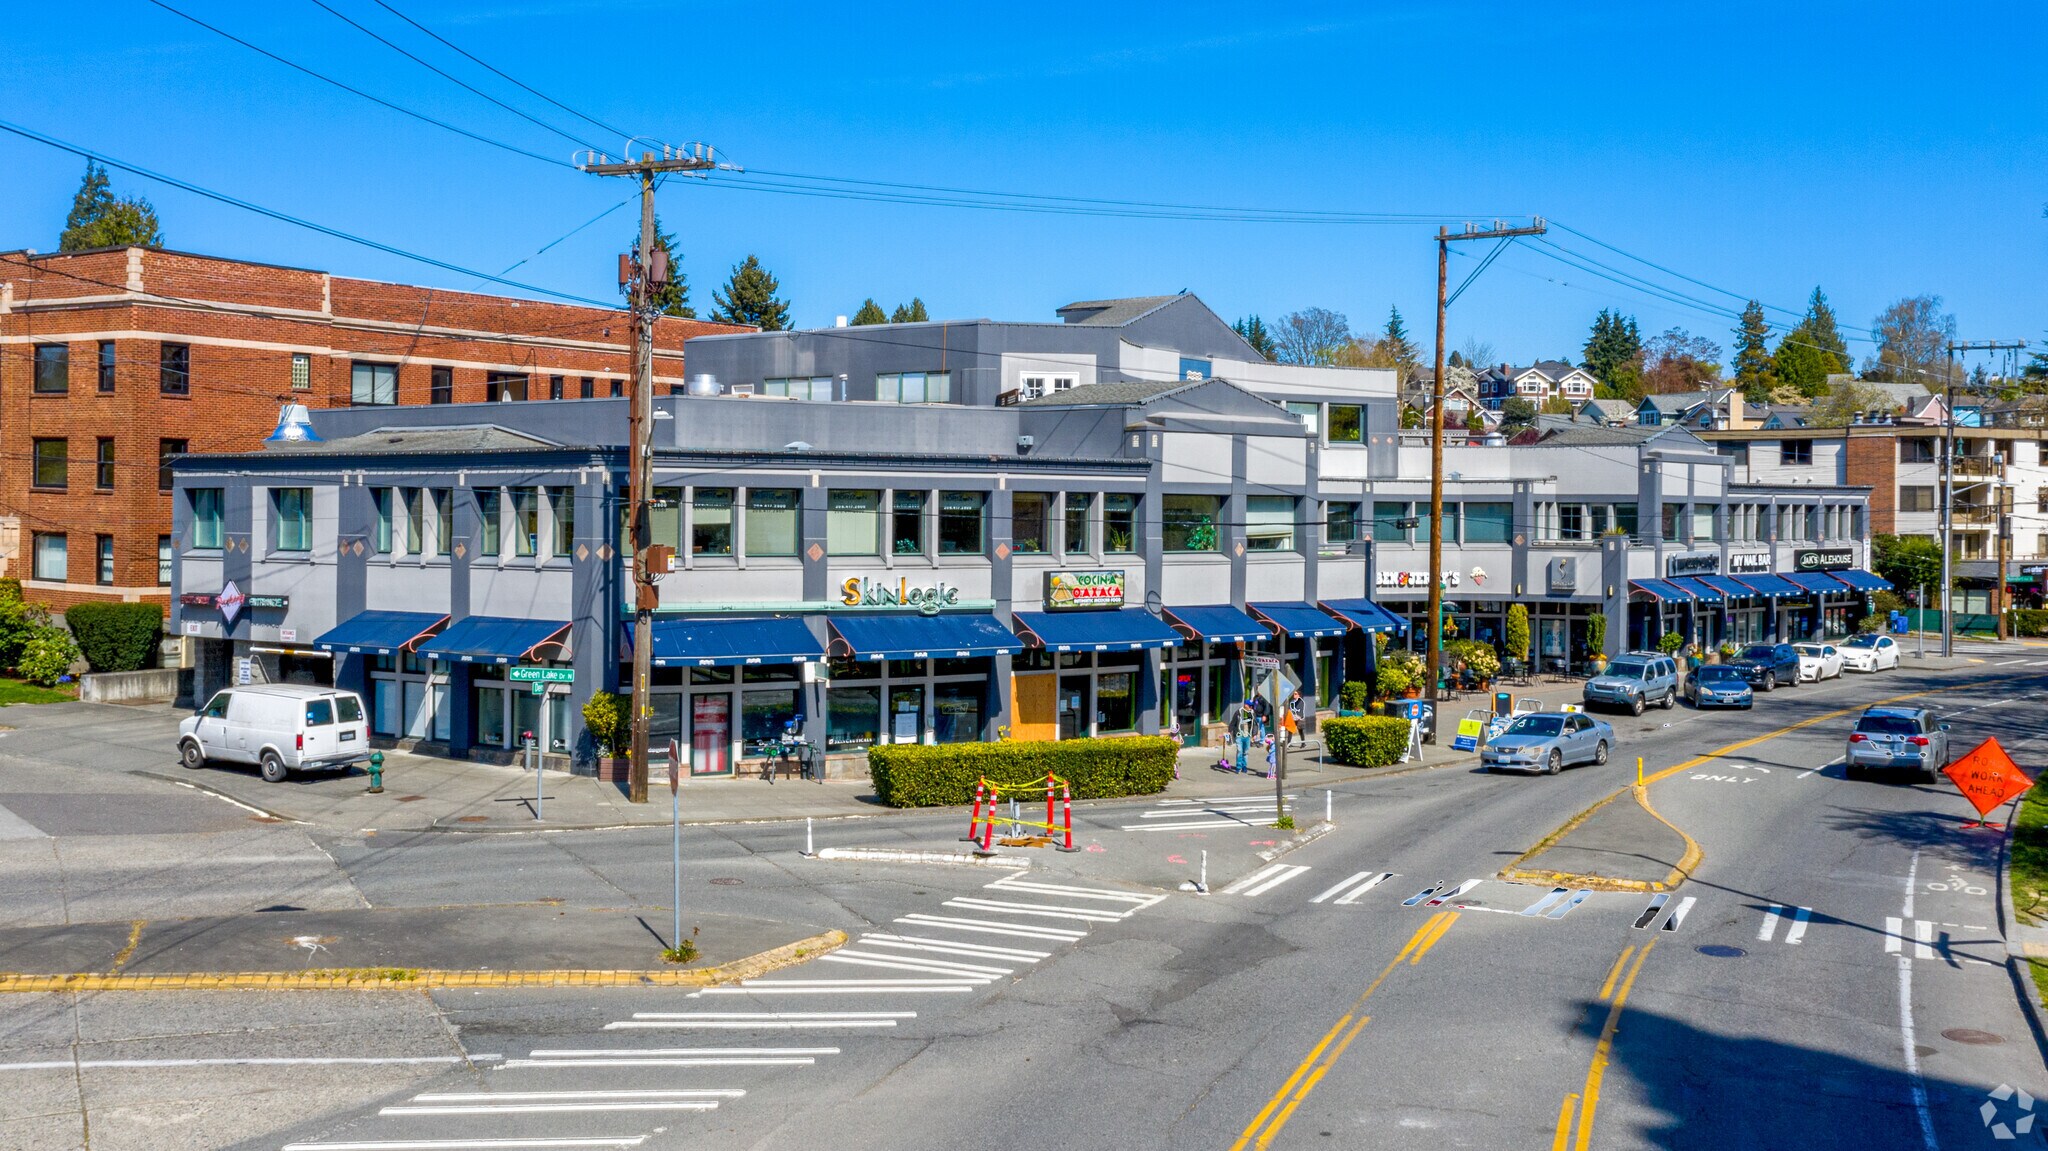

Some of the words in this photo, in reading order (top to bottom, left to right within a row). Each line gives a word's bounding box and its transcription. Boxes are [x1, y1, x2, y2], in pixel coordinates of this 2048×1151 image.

[1744, 554, 1758, 566] NAIL
[1758, 553, 1771, 565] BAR
[1820, 553, 1852, 565] ALEHOUSE
[1078, 574, 1117, 586] COCINA
[1376, 571, 1399, 585] BEN
[1072, 586, 1122, 598] OAXACA
[521, 669, 540, 679] Green
[542, 670, 558, 679] Lake
[1689, 774, 1759, 784] ONLY
[1971, 770, 2004, 783] WORK
[1968, 784, 2006, 799] AHEAD
